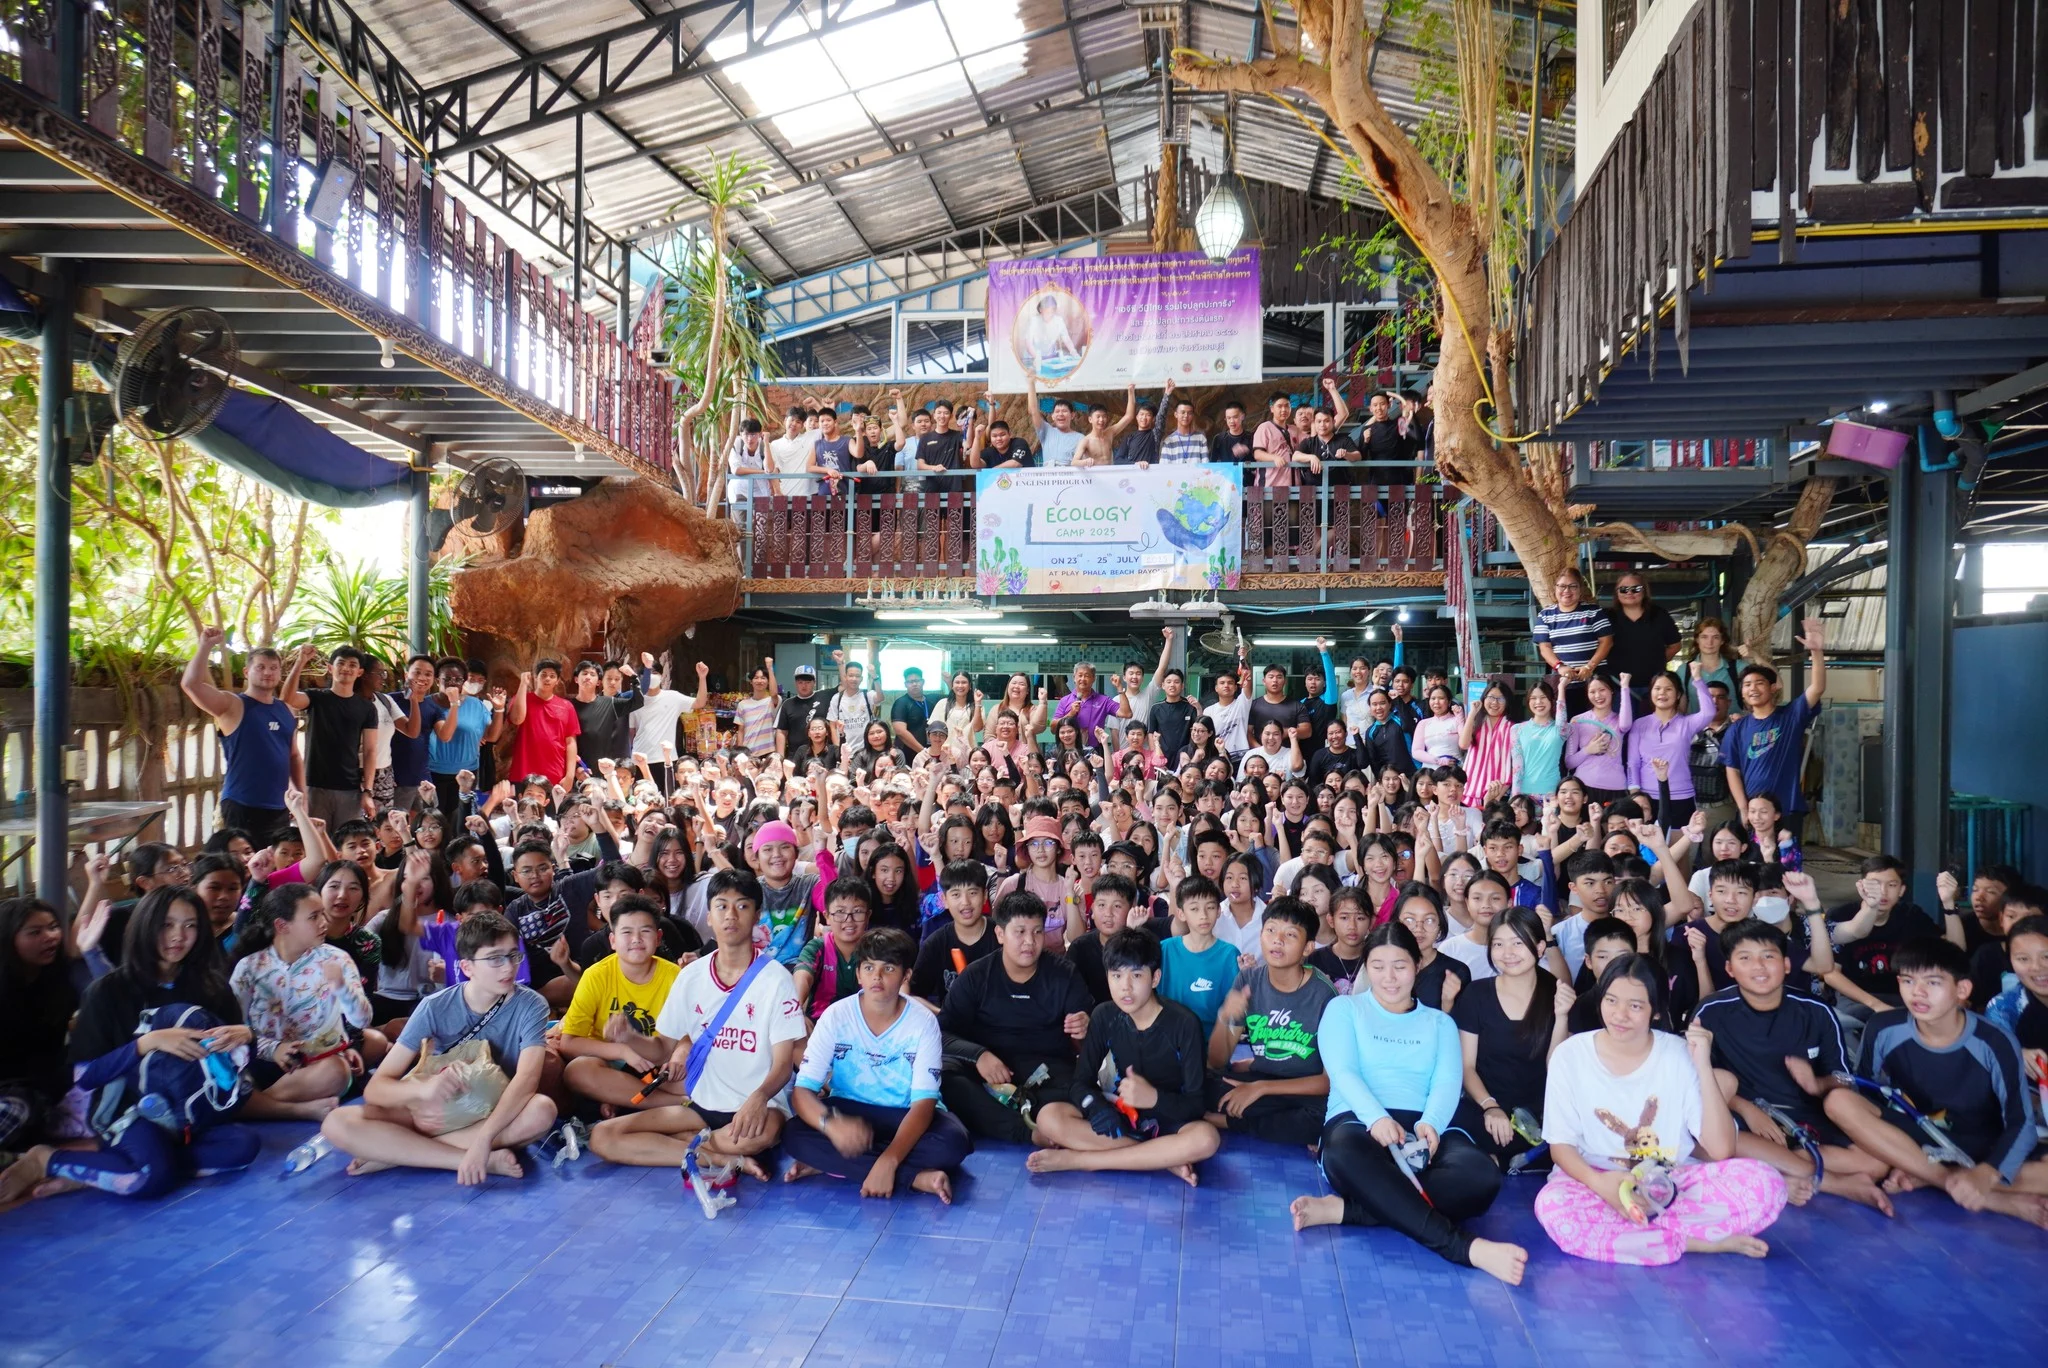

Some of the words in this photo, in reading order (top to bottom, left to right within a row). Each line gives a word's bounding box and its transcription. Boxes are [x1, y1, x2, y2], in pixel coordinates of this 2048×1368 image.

[1015, 479, 1050, 487] ENGLISH
[1046, 505, 1132, 524] ECOLOGY
[1056, 528, 1085, 537] CAMP
[1090, 527, 1116, 537] 2025
[1050, 557, 1065, 565] ON
[1116, 555, 1140, 564] JULY
[1196, 977, 1213, 988] NIKE
[480, 1005, 499, 1026] adidas
[1246, 1014, 1313, 1046] Superdry
